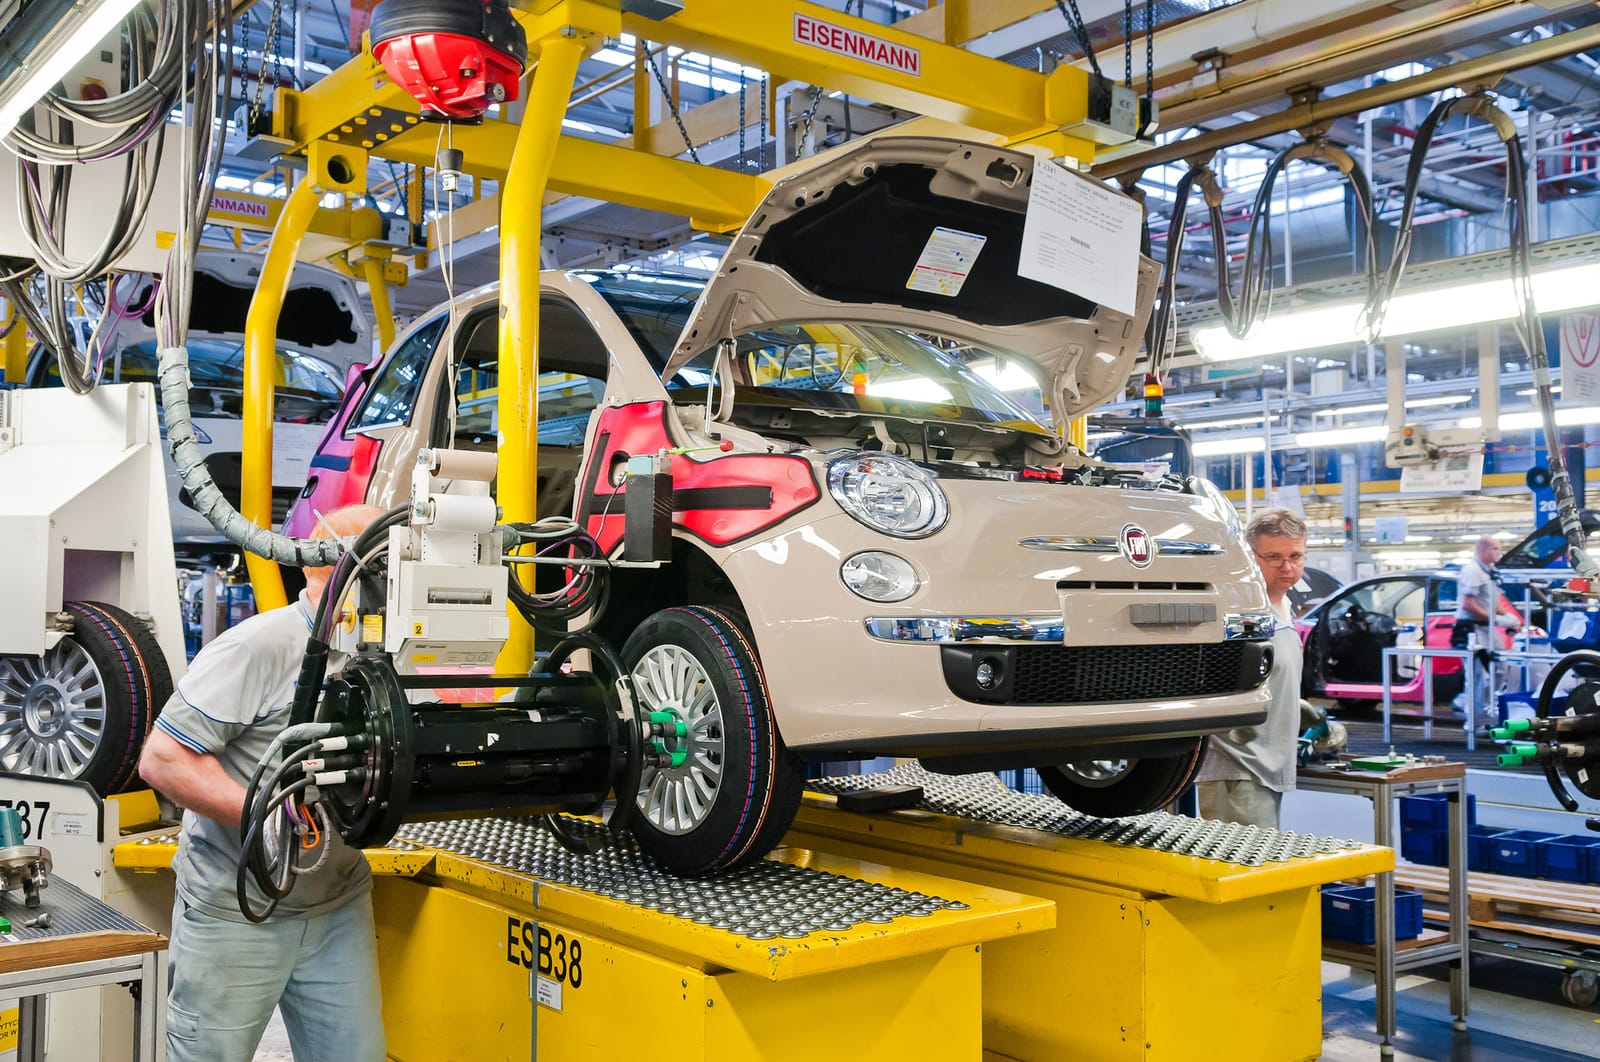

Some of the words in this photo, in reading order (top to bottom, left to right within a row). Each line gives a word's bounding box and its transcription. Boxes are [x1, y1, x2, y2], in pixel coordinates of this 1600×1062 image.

[798, 18, 917, 72] EISENMANN
[415, 625, 422, 635] 2
[0, 800, 50, 839] 37
[507, 916, 582, 989] ESB38
